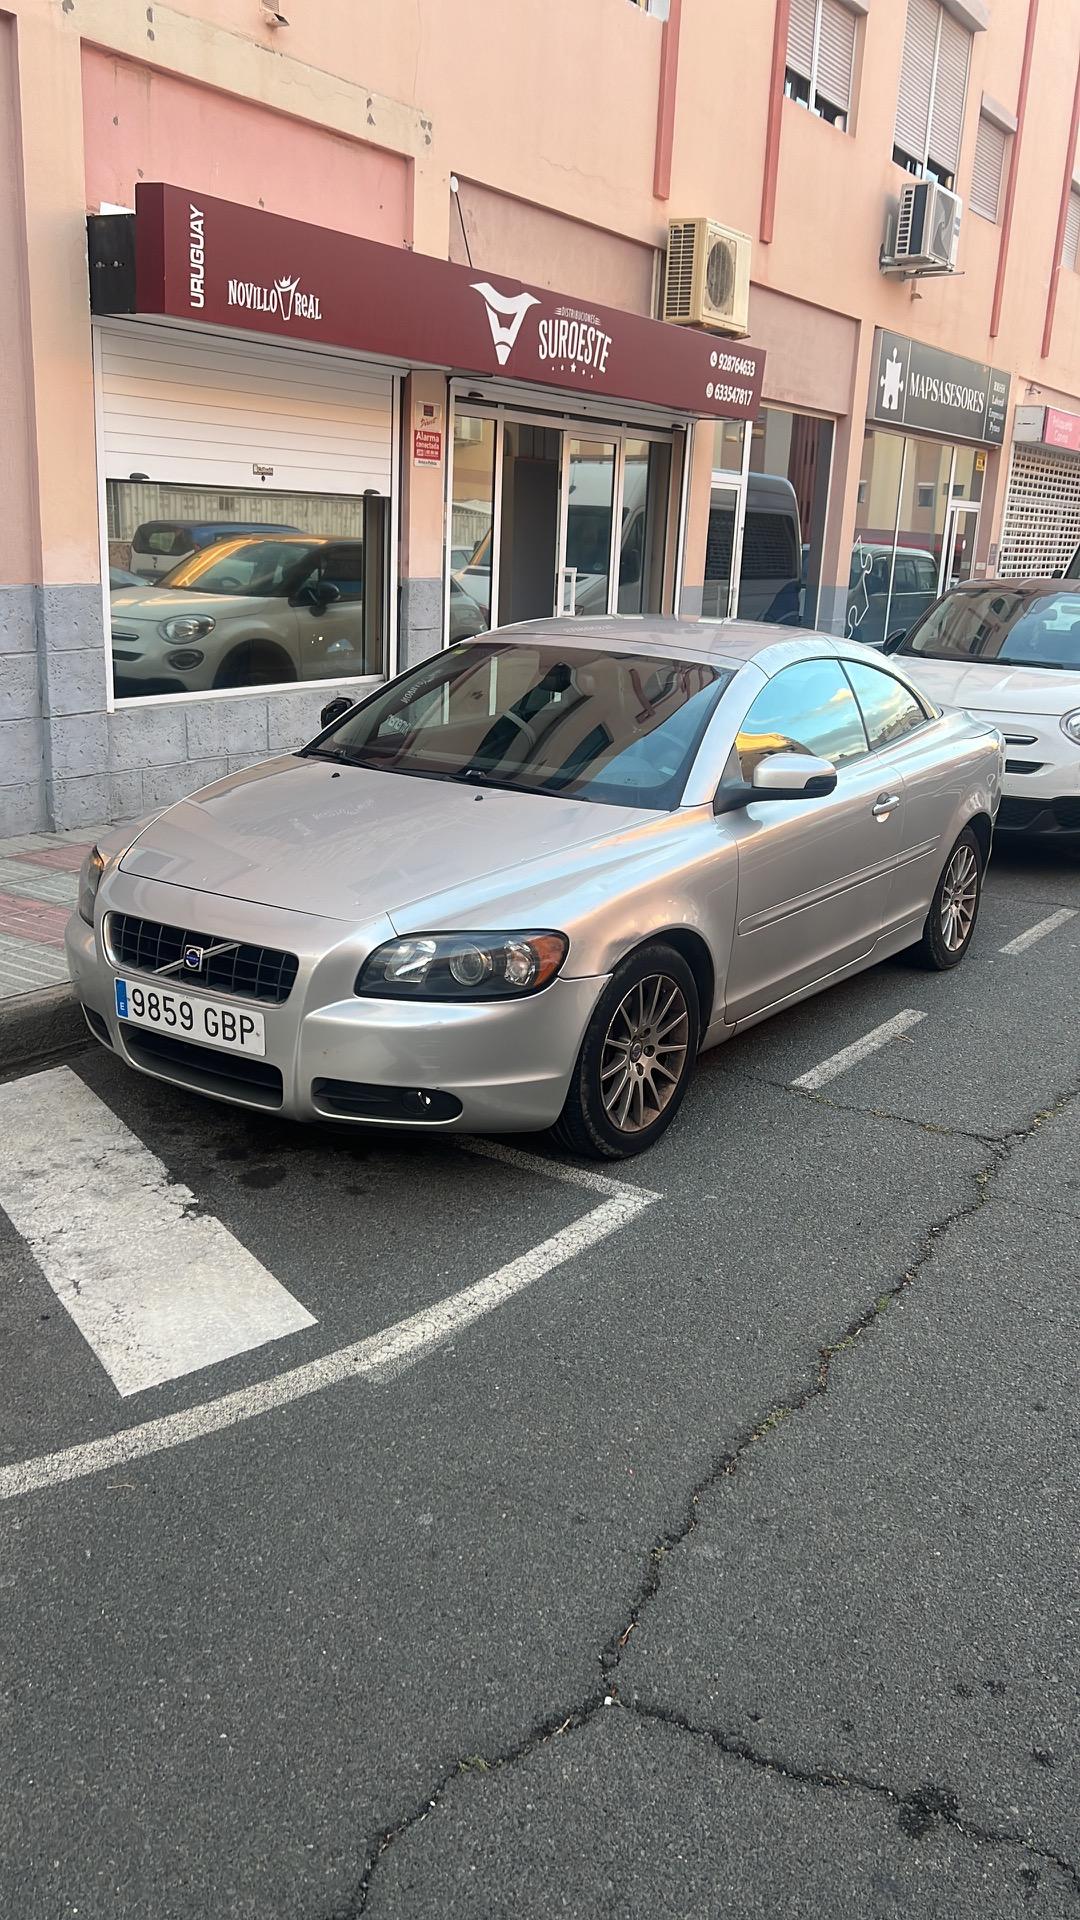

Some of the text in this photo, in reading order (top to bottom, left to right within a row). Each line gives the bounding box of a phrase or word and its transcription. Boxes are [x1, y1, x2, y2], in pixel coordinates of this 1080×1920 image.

[190, 203, 205, 308] URUGUAY
[228, 279, 278, 313] NOVILLO
[538, 319, 613, 374] SUROESTE
[718, 353, 756, 377] 928764633
[714, 383, 754, 406] 633547817
[909, 372, 985, 413] MAPSASESORES
[416, 431, 439, 442] Alarma
[119, 1002, 125, 1011] E
[131, 988, 255, 1045] 9859 GBP
